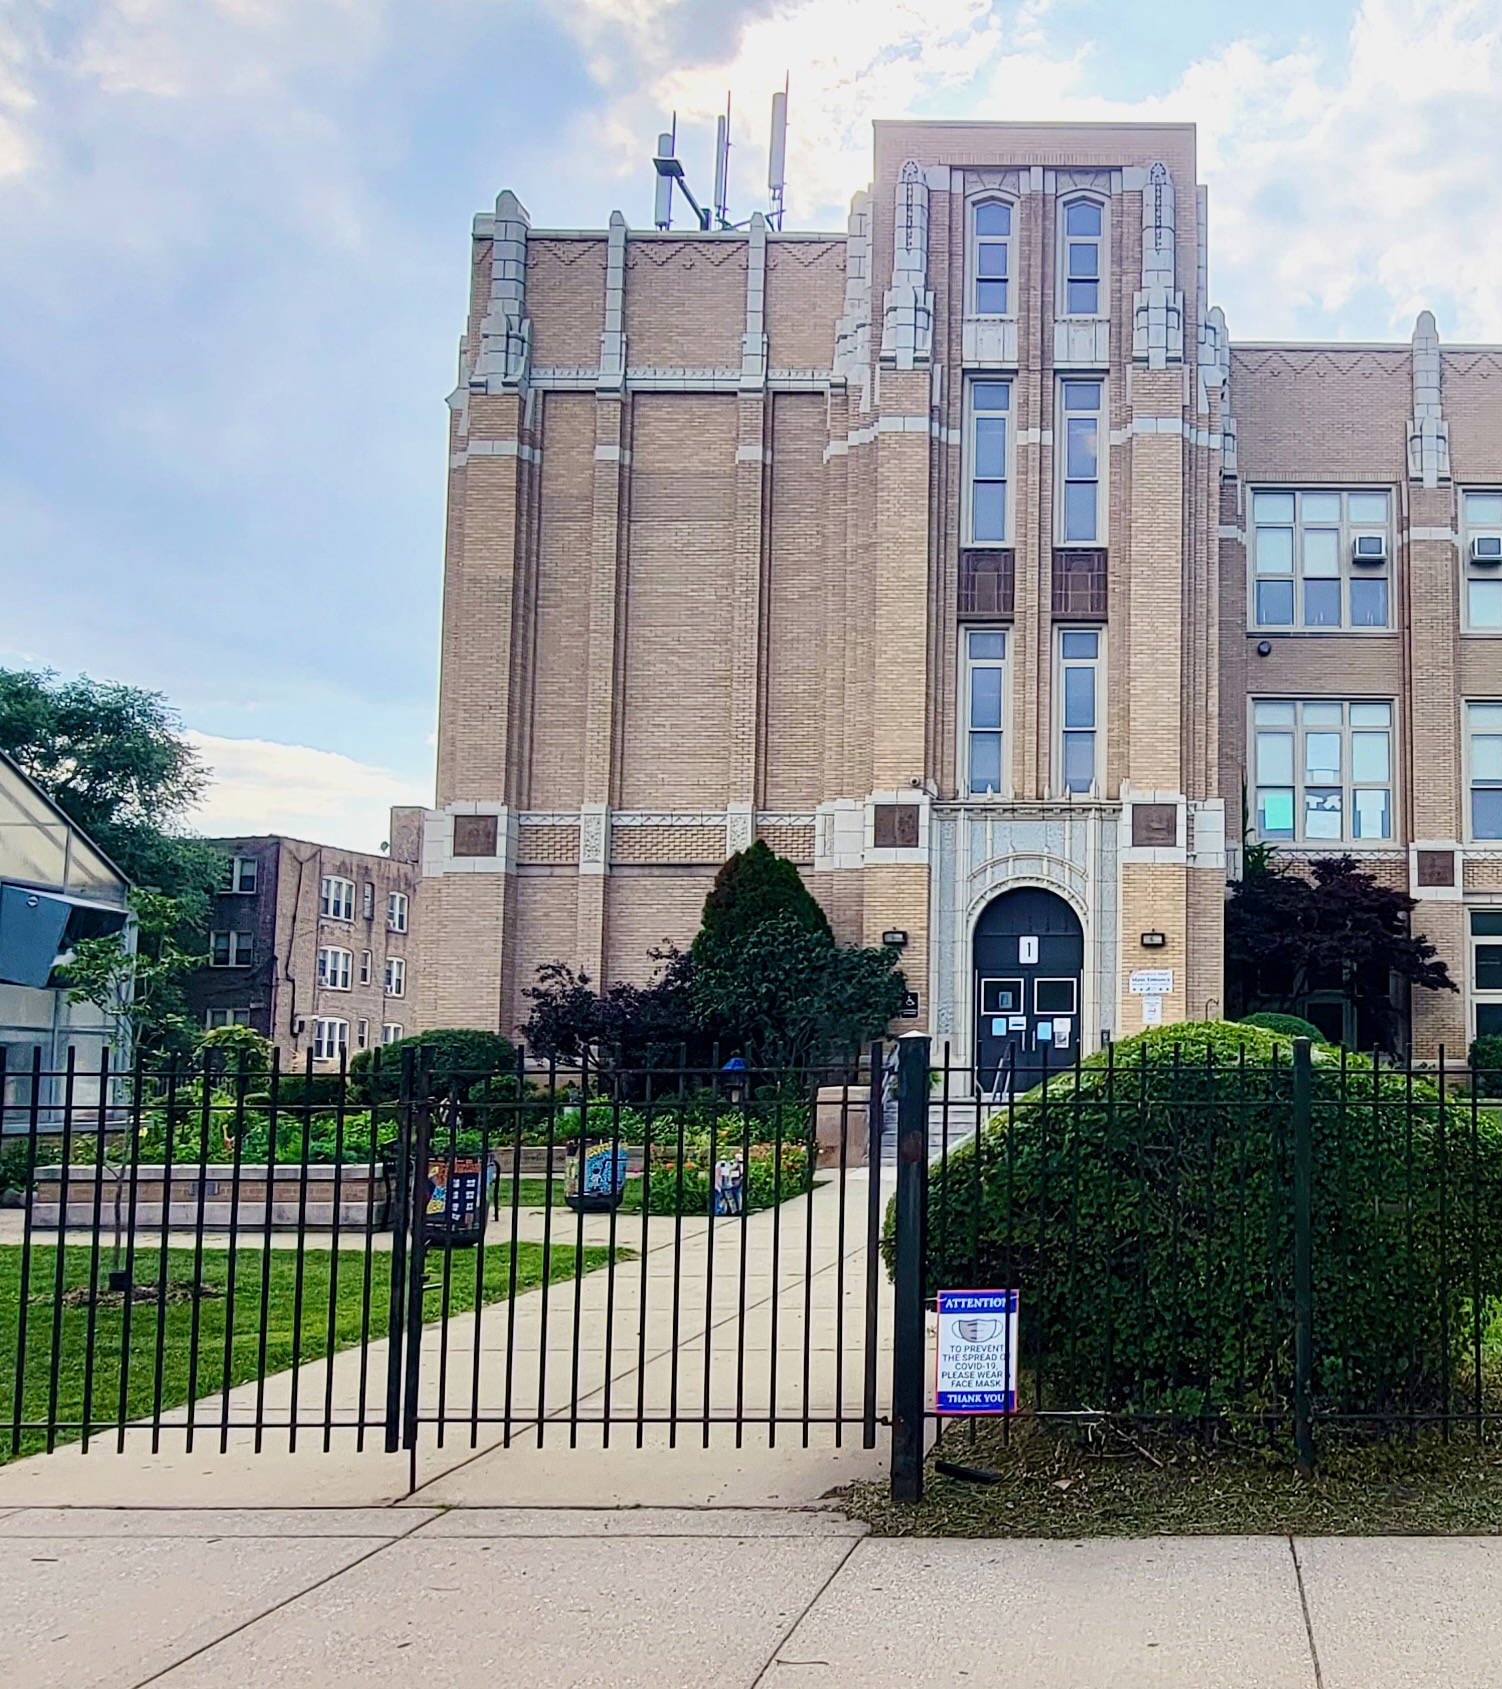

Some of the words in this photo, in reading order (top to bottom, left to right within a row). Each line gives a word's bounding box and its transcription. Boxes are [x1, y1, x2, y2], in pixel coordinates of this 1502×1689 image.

[1027, 942, 1031, 957] 1
[950, 1345, 962, 1353] TO
[964, 1344, 1004, 1353] PREVENT
[942, 1353, 961, 1362] THE
[962, 1353, 998, 1361] SPREAD
[955, 1362, 999, 1371] COVID-19,
[941, 1371, 975, 1379] PLEASE
[977, 1370, 1003, 1379] WEAR
[951, 1380, 974, 1388] FACE
[947, 1394, 982, 1403] THANK
[984, 1393, 1005, 1403] YOU
